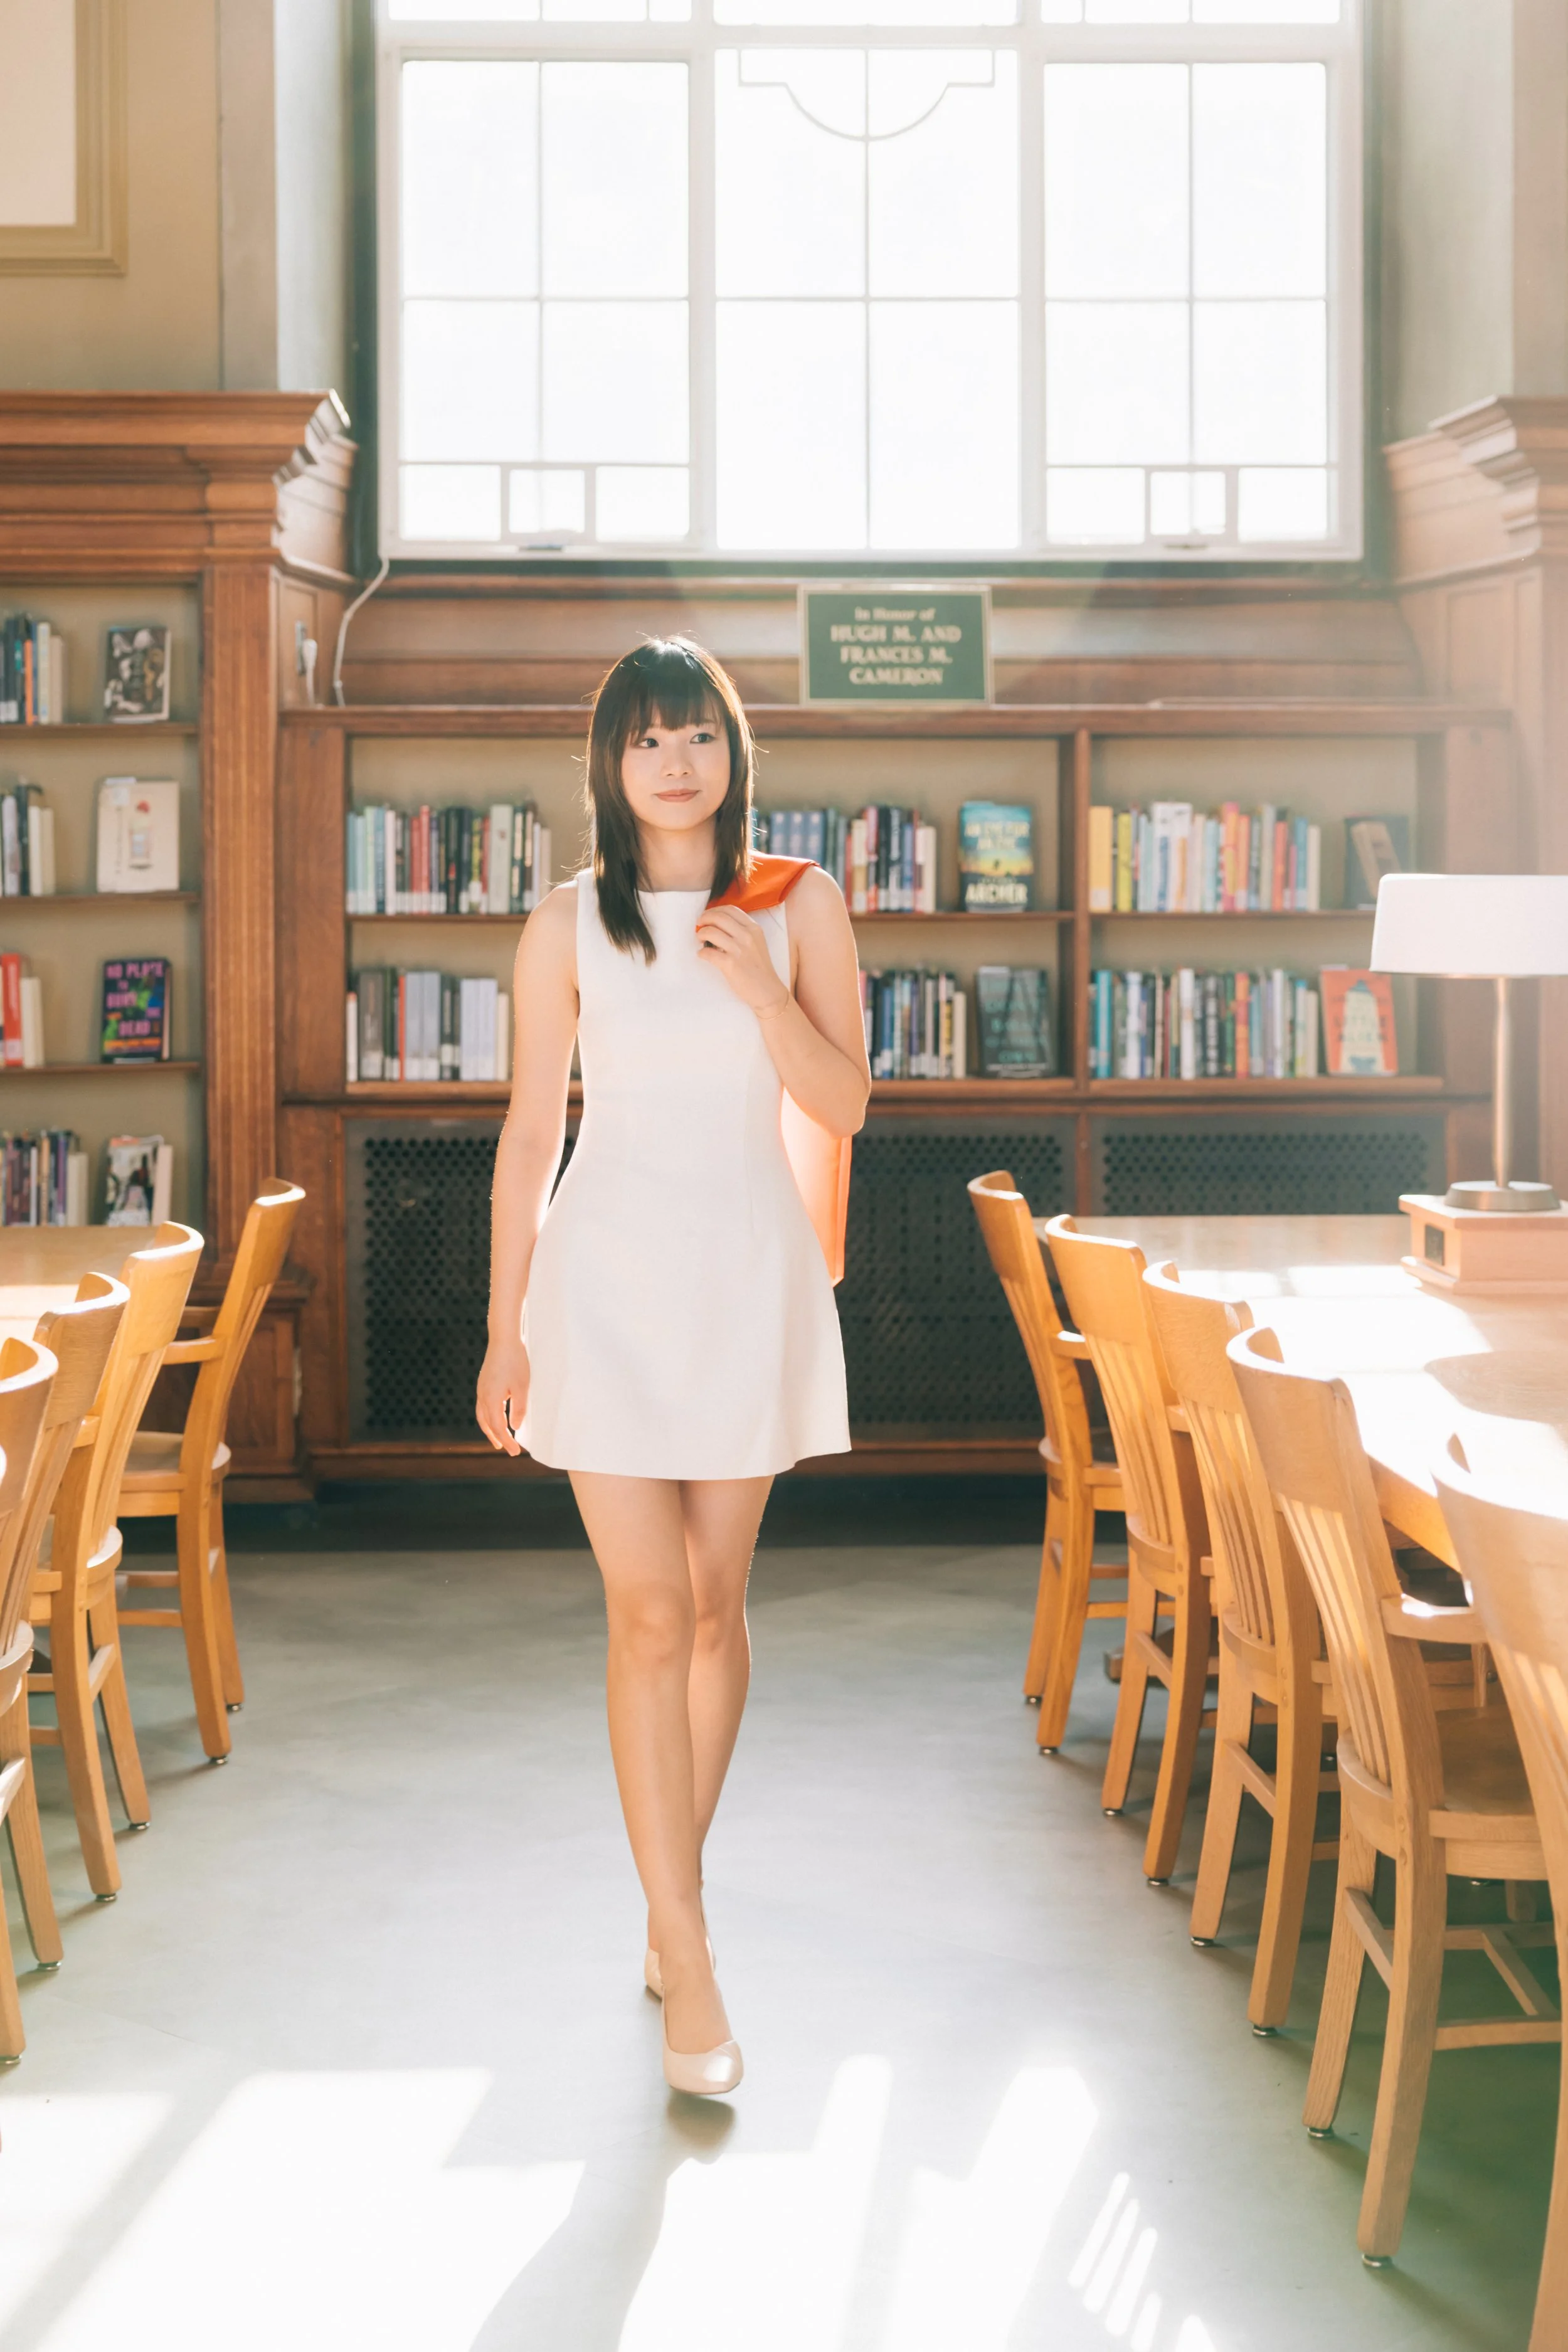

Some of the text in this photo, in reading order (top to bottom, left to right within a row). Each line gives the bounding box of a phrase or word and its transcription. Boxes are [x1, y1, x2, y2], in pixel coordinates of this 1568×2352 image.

[919, 607, 936, 622] of
[830, 625, 962, 643] HUGH M. AND
[928, 647, 953, 664] M.
[849, 667, 944, 686] CAMERON
[965, 883, 1029, 904] ARCHER
